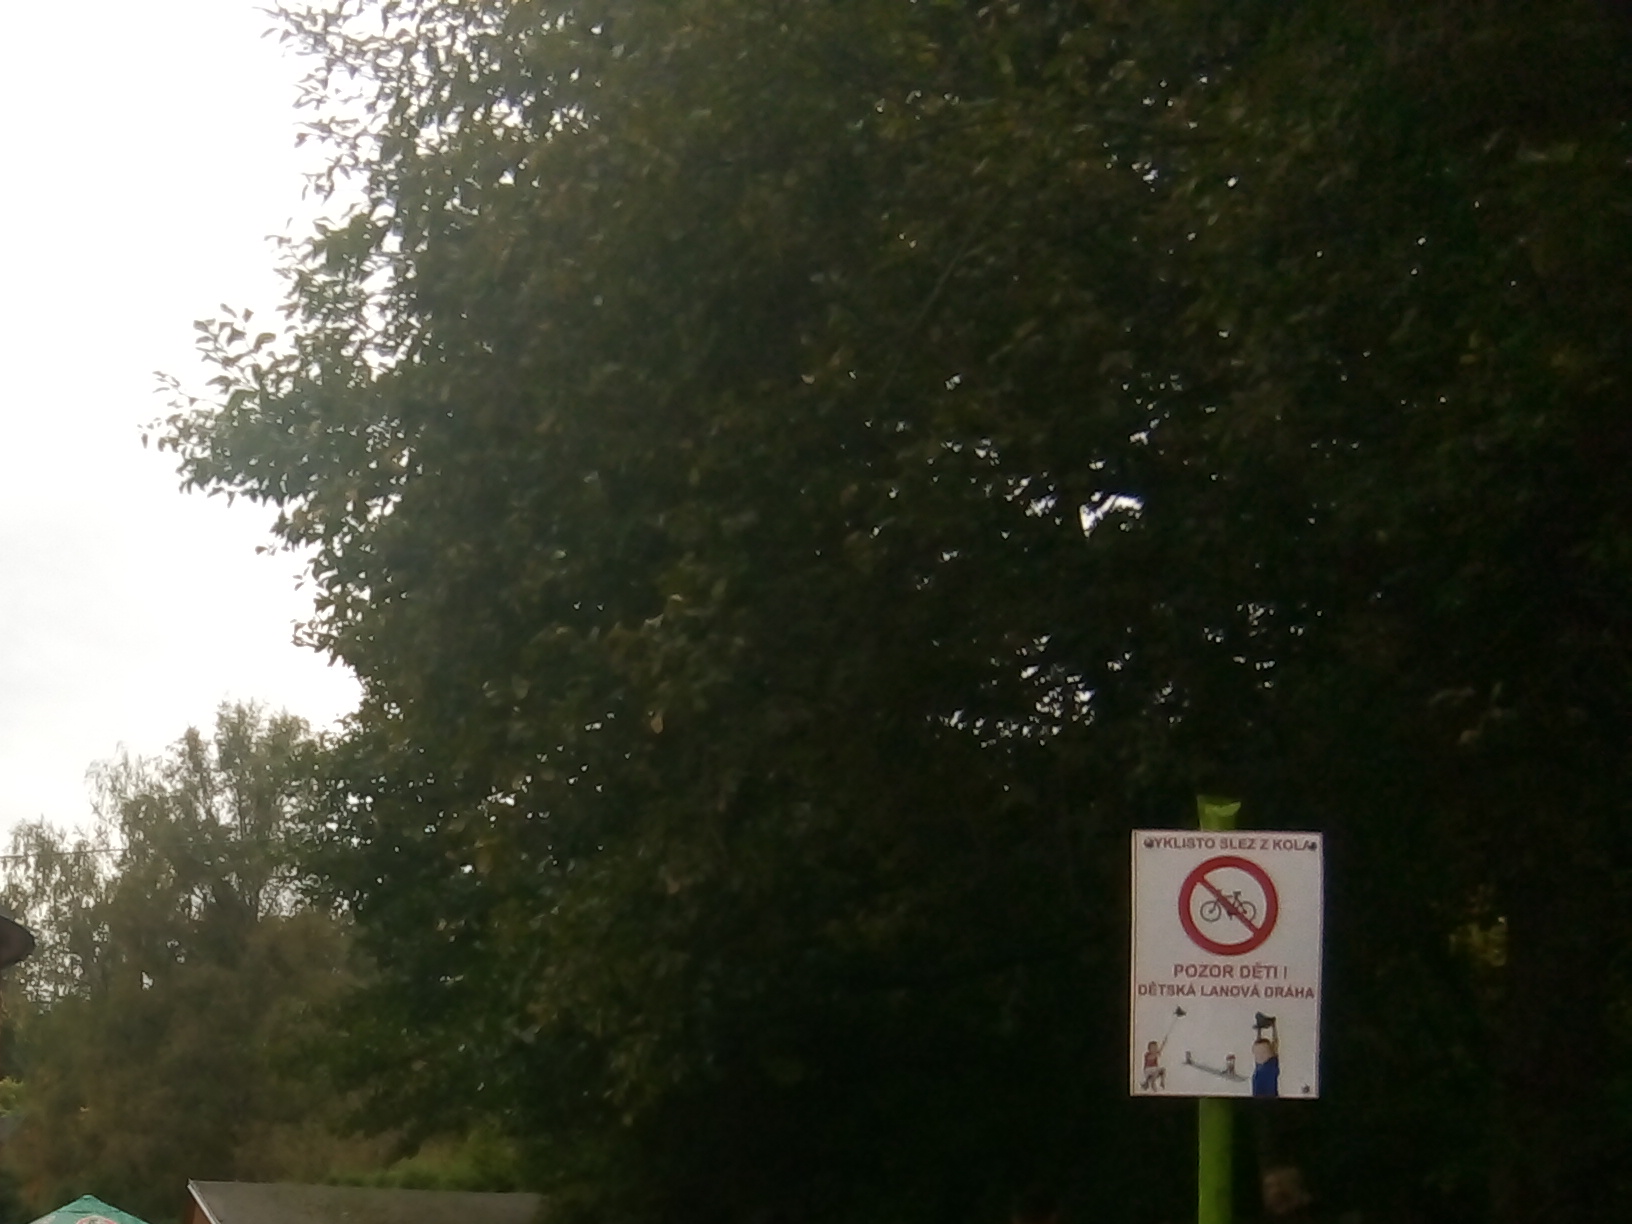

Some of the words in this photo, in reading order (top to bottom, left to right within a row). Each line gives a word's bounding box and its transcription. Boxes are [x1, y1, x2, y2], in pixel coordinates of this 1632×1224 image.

[1143, 837, 1216, 850] YKLISTO
[1220, 838, 1256, 850] SLEZ
[1259, 838, 1269, 850] Z
[1173, 963, 1234, 978] POZOR
[1239, 961, 1278, 979] DĚTI
[1137, 980, 1196, 996] DĚTSKÁ
[1200, 983, 1260, 998] LANOVÁ
[1264, 984, 1316, 999] DRÁHA
